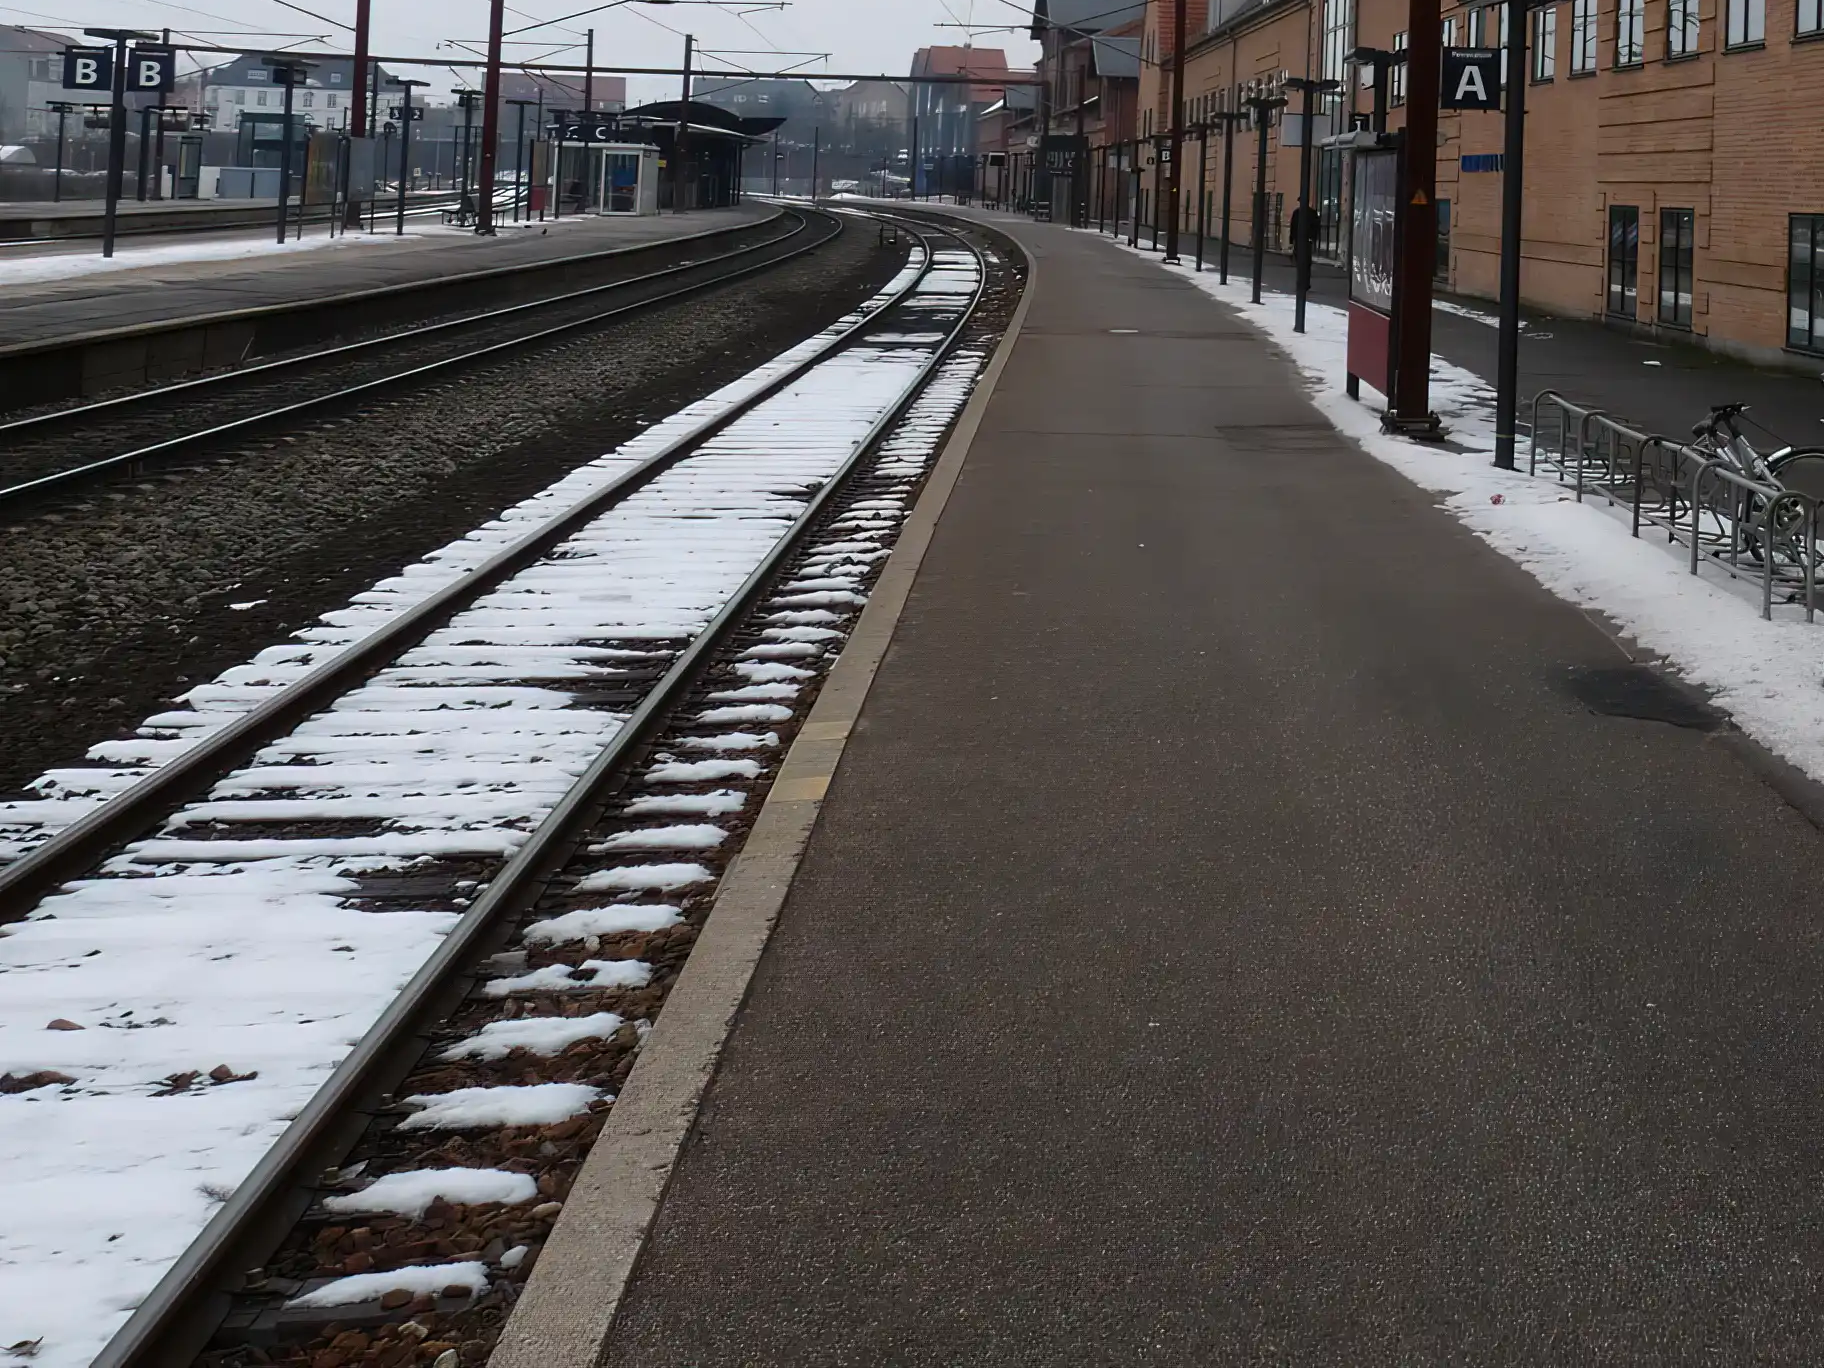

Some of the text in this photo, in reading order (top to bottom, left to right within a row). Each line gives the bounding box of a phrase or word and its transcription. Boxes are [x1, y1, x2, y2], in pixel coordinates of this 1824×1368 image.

[75, 58, 98, 84] B
[139, 60, 161, 86] B
[1454, 65, 1487, 101] A
